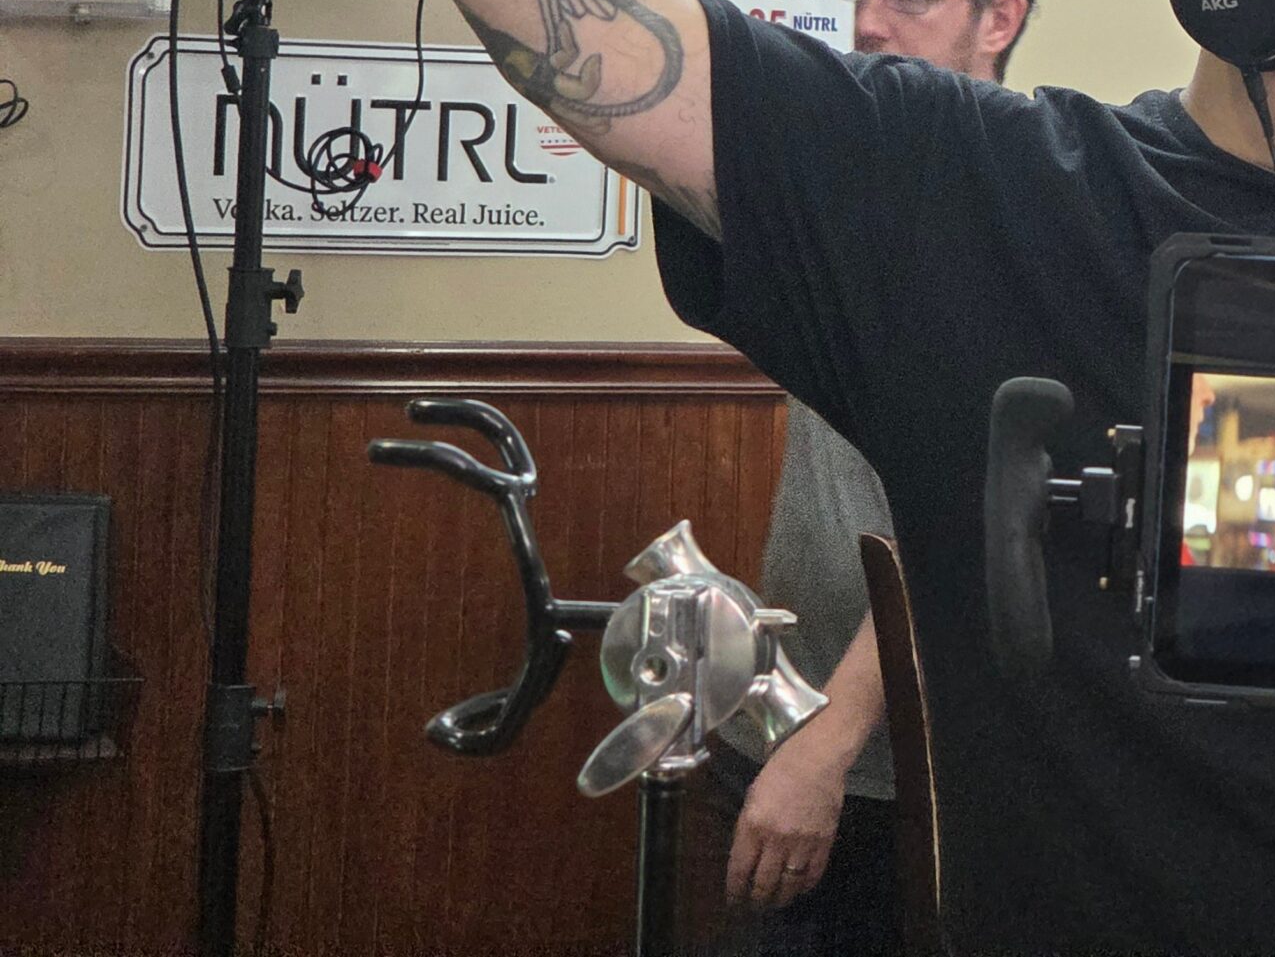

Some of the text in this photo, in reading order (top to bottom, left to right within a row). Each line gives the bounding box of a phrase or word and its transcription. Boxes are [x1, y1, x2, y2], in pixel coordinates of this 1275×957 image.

[793, 11, 838, 33] NÜTRL
[212, 198, 545, 227] Vka. Seltzer. Real Juice.
[36, 560, 66, 576] You
